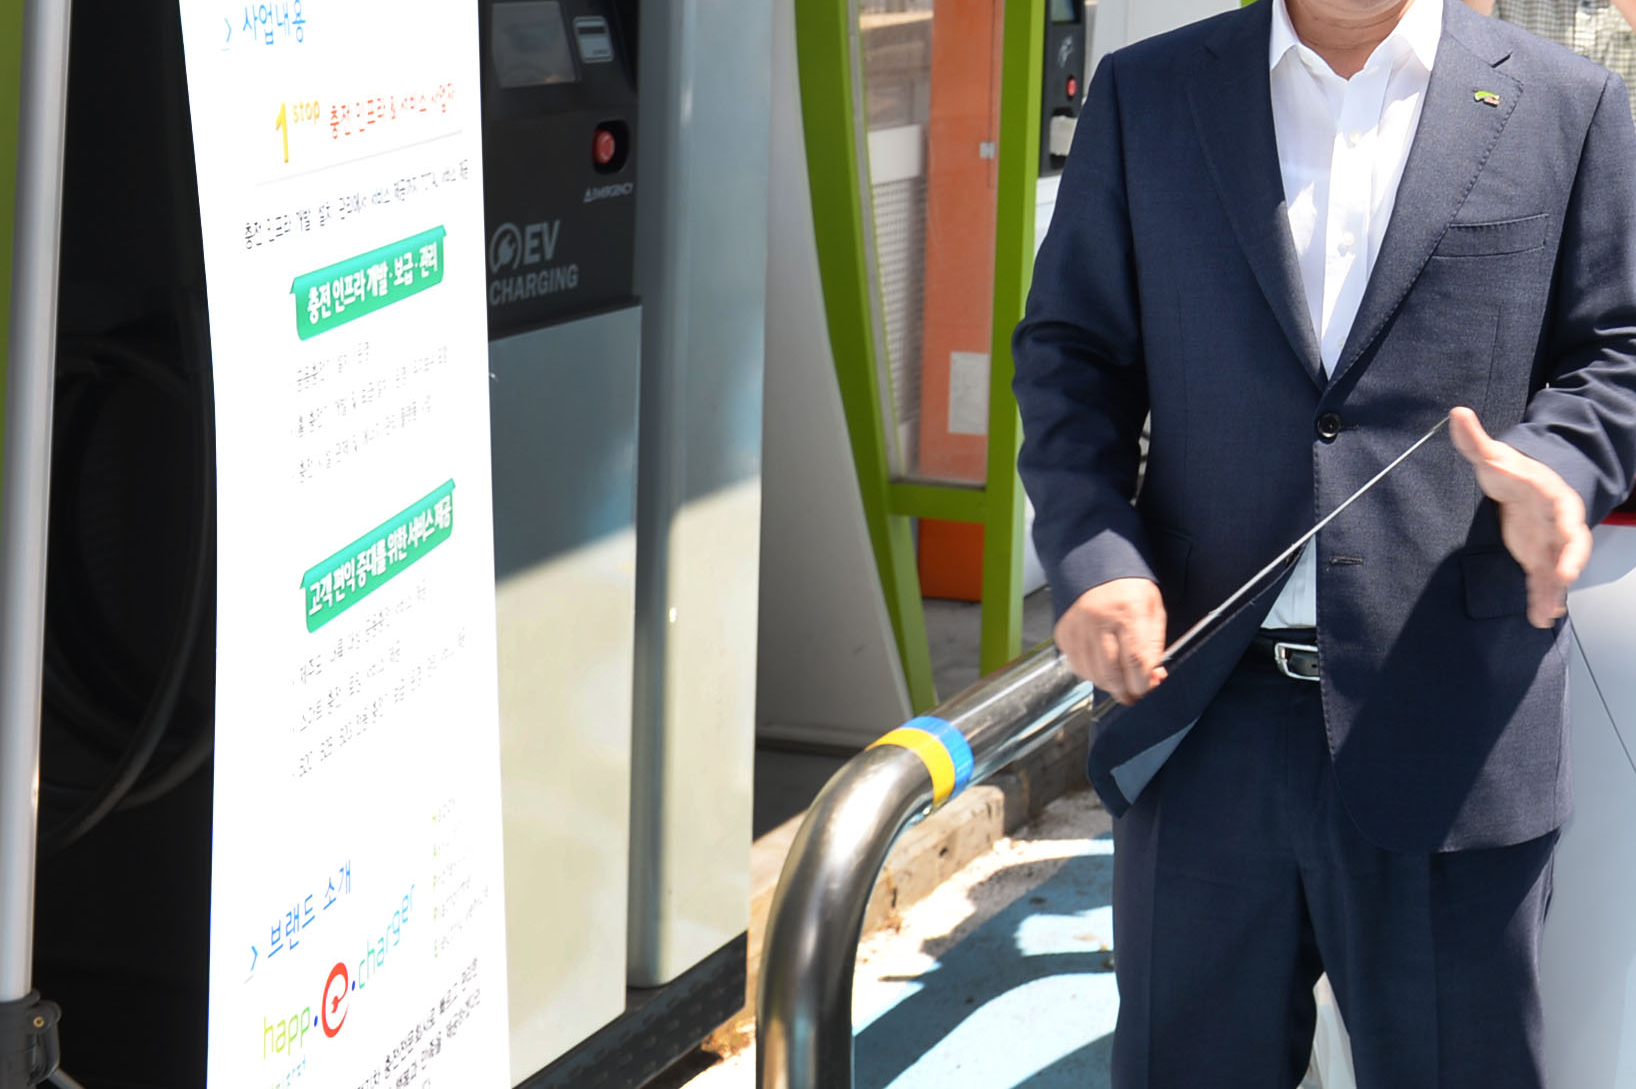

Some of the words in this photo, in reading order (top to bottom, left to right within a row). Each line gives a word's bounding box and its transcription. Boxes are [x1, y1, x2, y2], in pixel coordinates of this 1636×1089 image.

[523, 219, 561, 265] EV
[307, 281, 331, 325] 충전
[332, 269, 366, 314] 인프라
[489, 263, 579, 306] CHARGING
[309, 572, 333, 616] 고객
[267, 893, 316, 959] 브랜드
[322, 855, 351, 911] 소개
